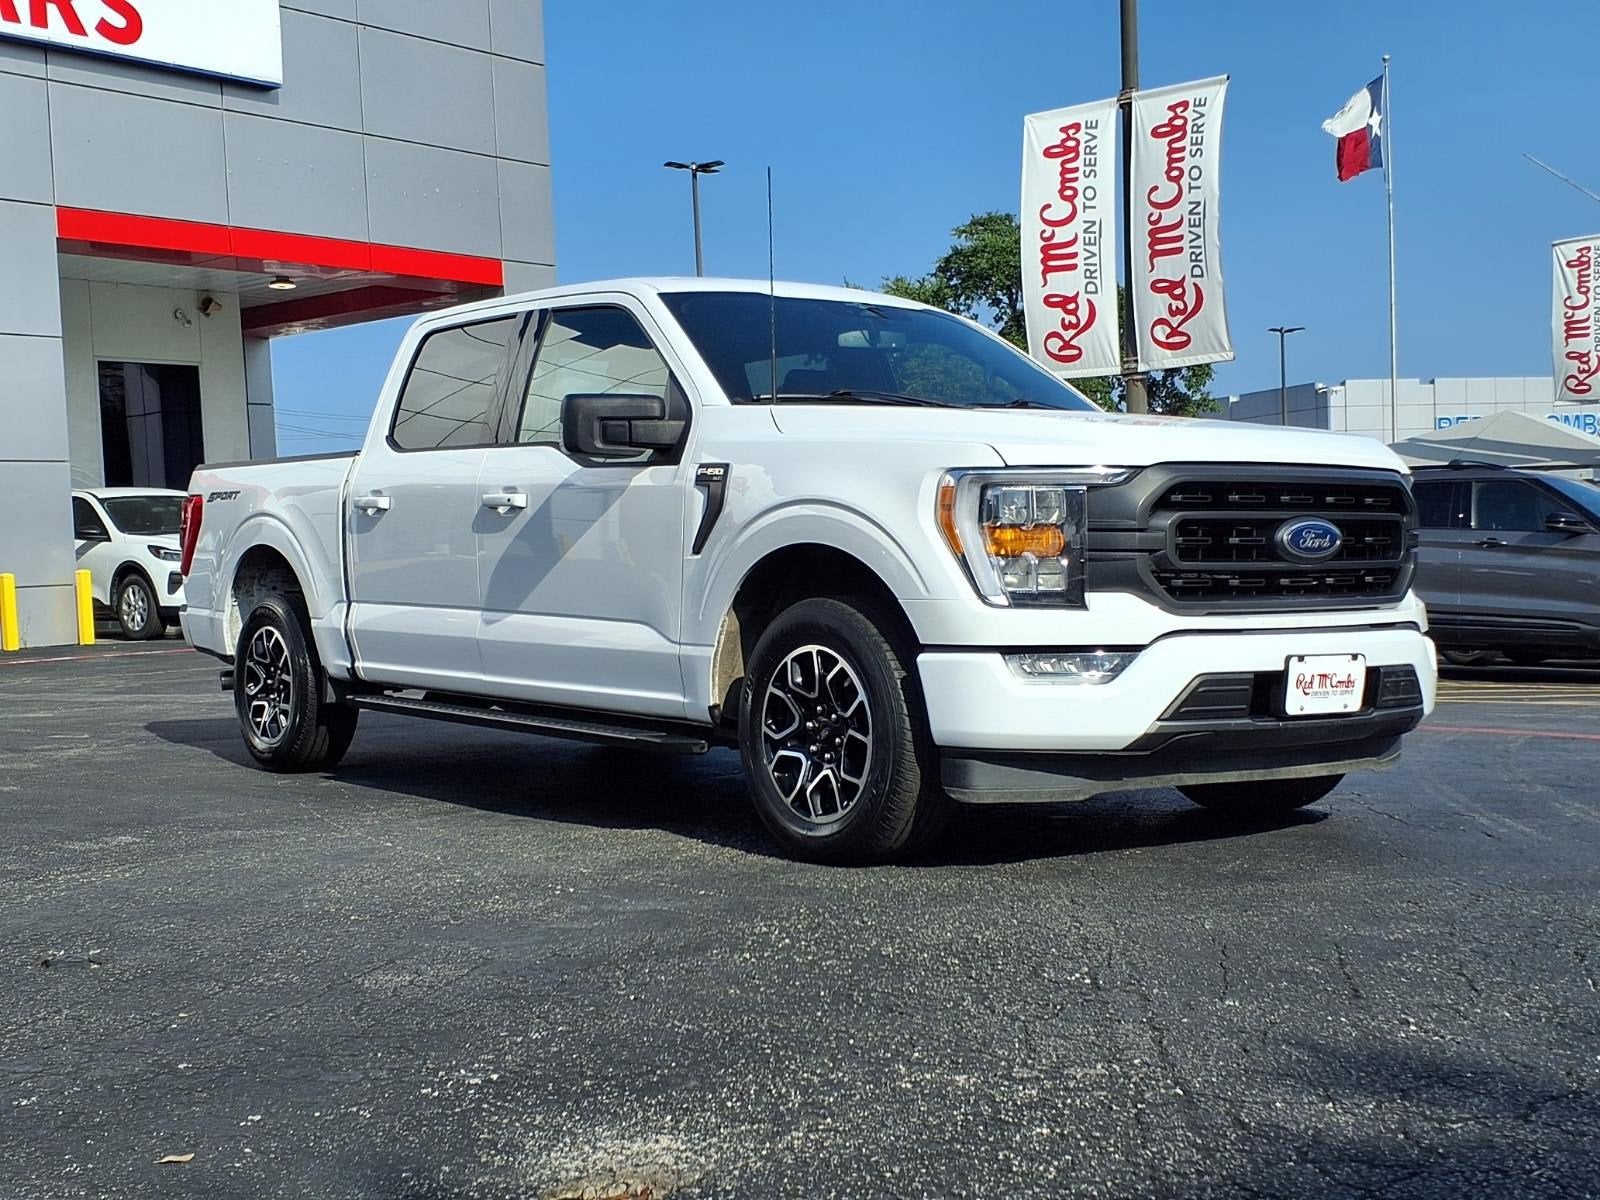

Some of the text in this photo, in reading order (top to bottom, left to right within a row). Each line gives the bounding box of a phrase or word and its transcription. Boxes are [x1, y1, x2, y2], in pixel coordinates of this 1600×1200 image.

[1039, 122, 1097, 364] Red McCombs
[1082, 119, 1099, 295] DRIVEN TO SERVE
[1147, 100, 1204, 351] Red McCombs
[1188, 97, 1208, 279] DRIVEN TO SERVE
[1563, 246, 1600, 395] Red McCombs
[206, 491, 241, 503] SPORT
[1299, 528, 1331, 549] Ford
[1296, 672, 1356, 696] Red McCombs
